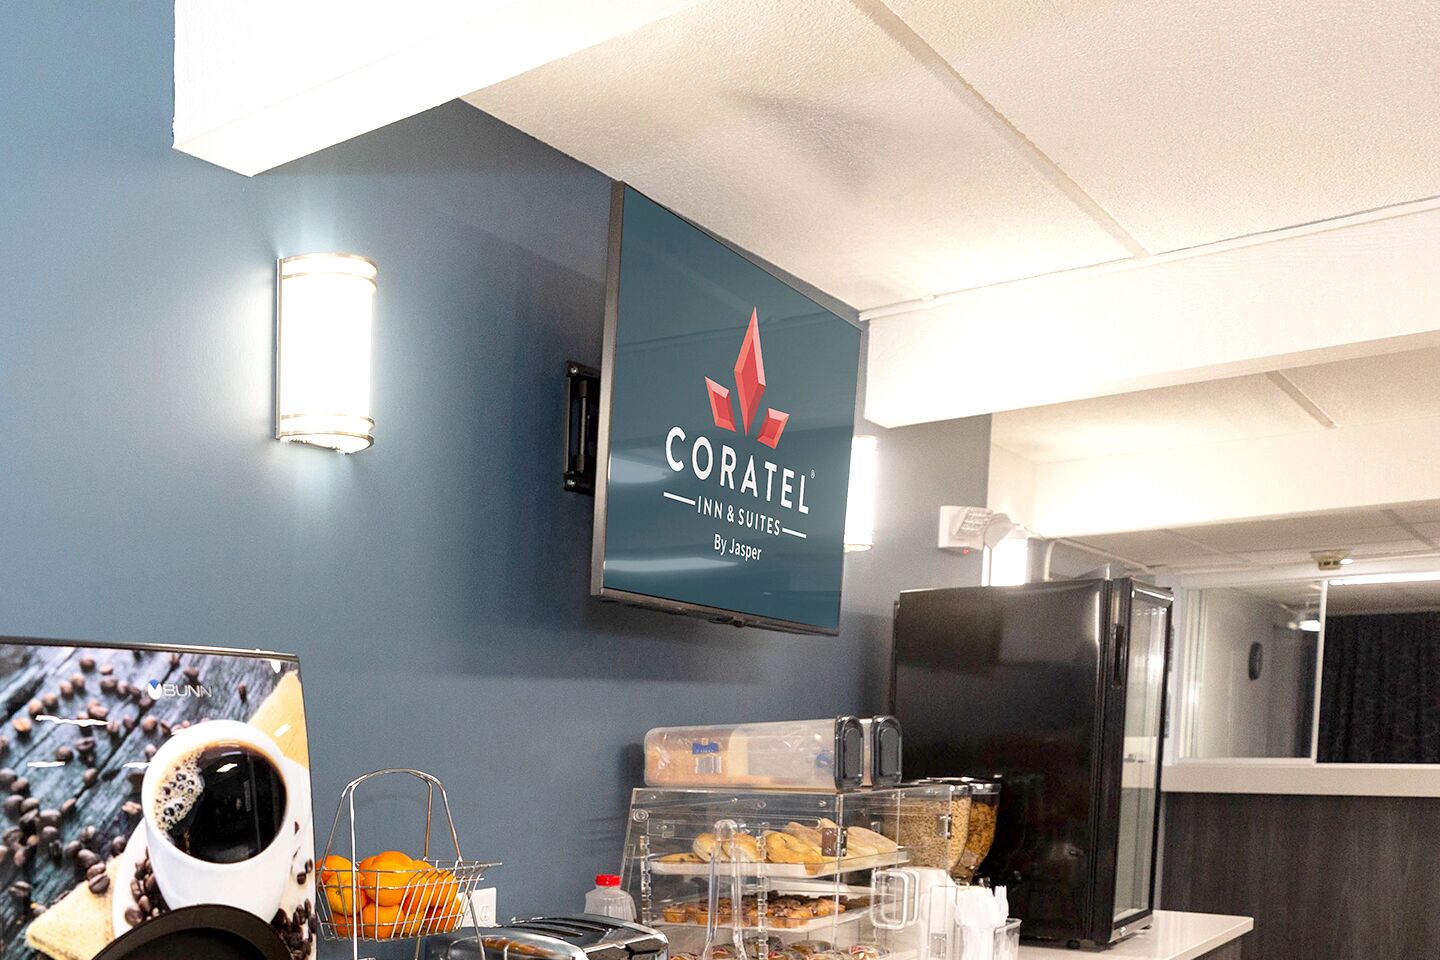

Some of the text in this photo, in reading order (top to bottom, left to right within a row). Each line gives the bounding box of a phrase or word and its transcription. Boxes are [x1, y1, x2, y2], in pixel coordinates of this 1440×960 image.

[665, 426, 809, 515] CORATEL
[697, 495, 780, 536] INN & SUITES
[714, 533, 762, 562] By Jasper
[162, 683, 213, 697] BUNN
